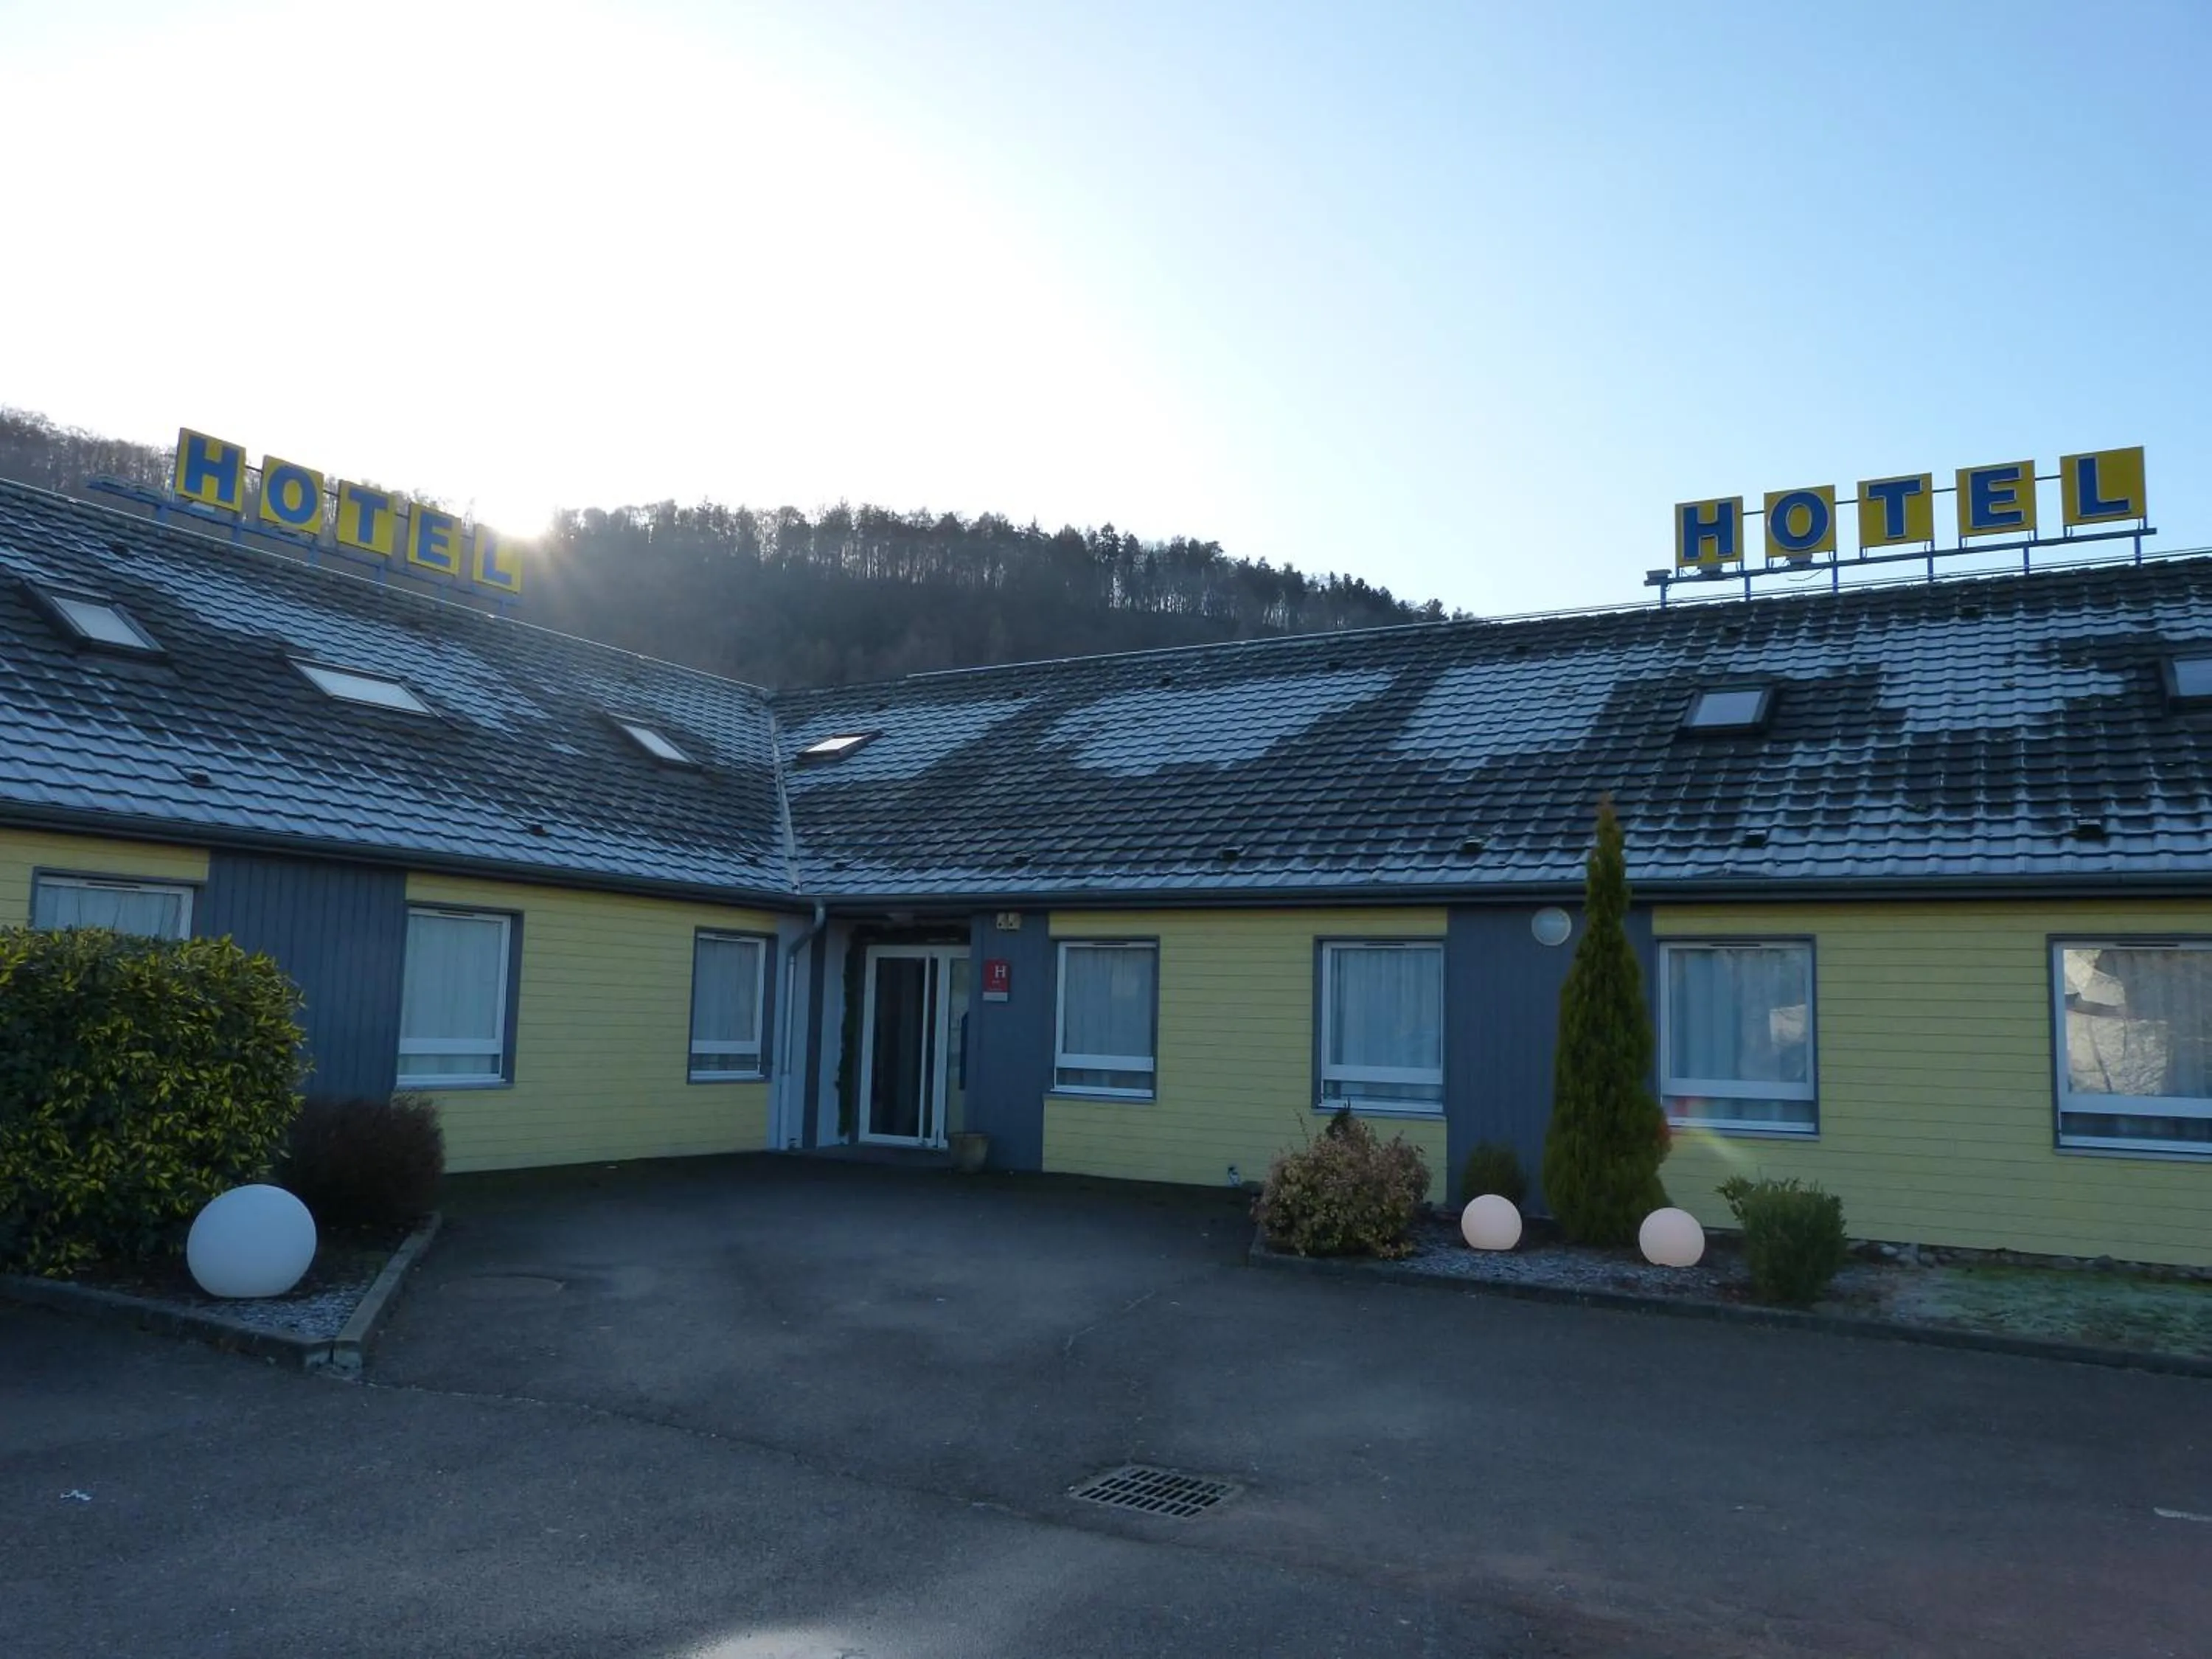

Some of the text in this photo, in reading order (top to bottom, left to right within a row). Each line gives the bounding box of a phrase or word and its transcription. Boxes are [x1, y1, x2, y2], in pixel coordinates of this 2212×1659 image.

[184, 435, 512, 585] HOTEL
[1682, 456, 2131, 559] HOTEL
[995, 964, 1006, 978] H
